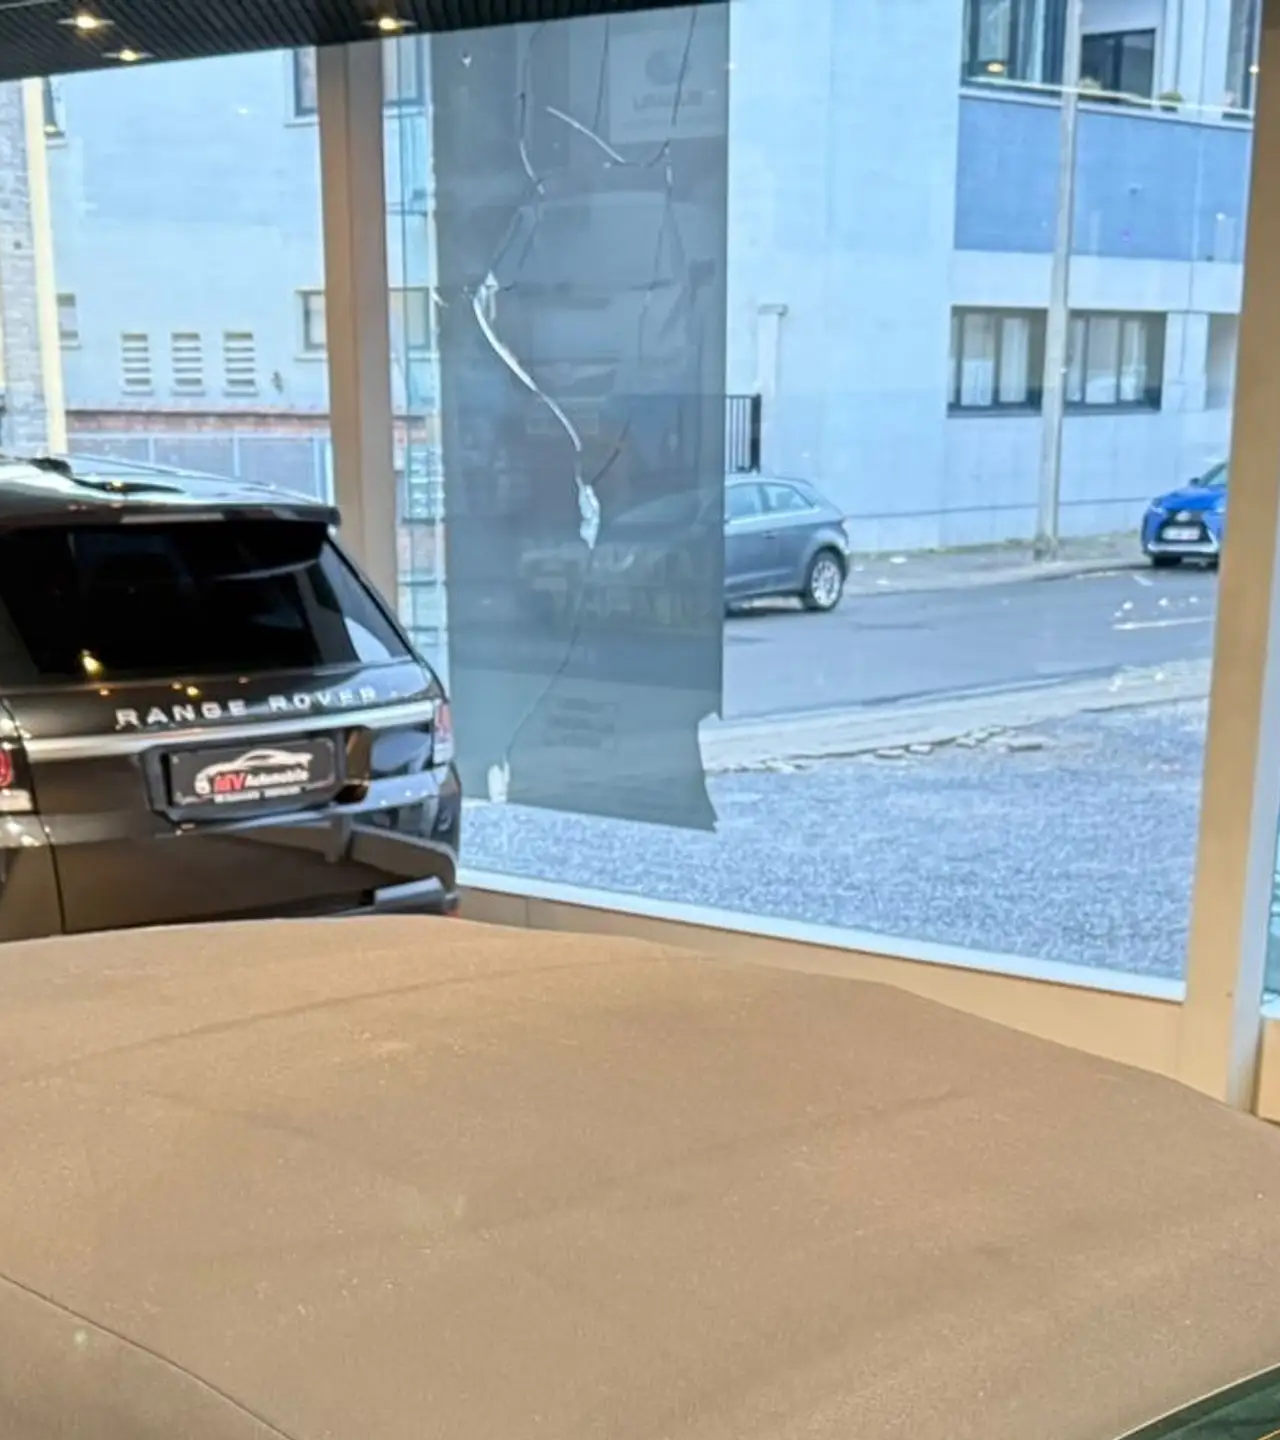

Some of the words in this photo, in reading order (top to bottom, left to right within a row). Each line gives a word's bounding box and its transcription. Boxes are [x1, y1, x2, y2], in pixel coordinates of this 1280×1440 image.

[115, 699, 247, 728] RANGE
[268, 686, 377, 712] ROVER
[214, 772, 247, 793] MV
